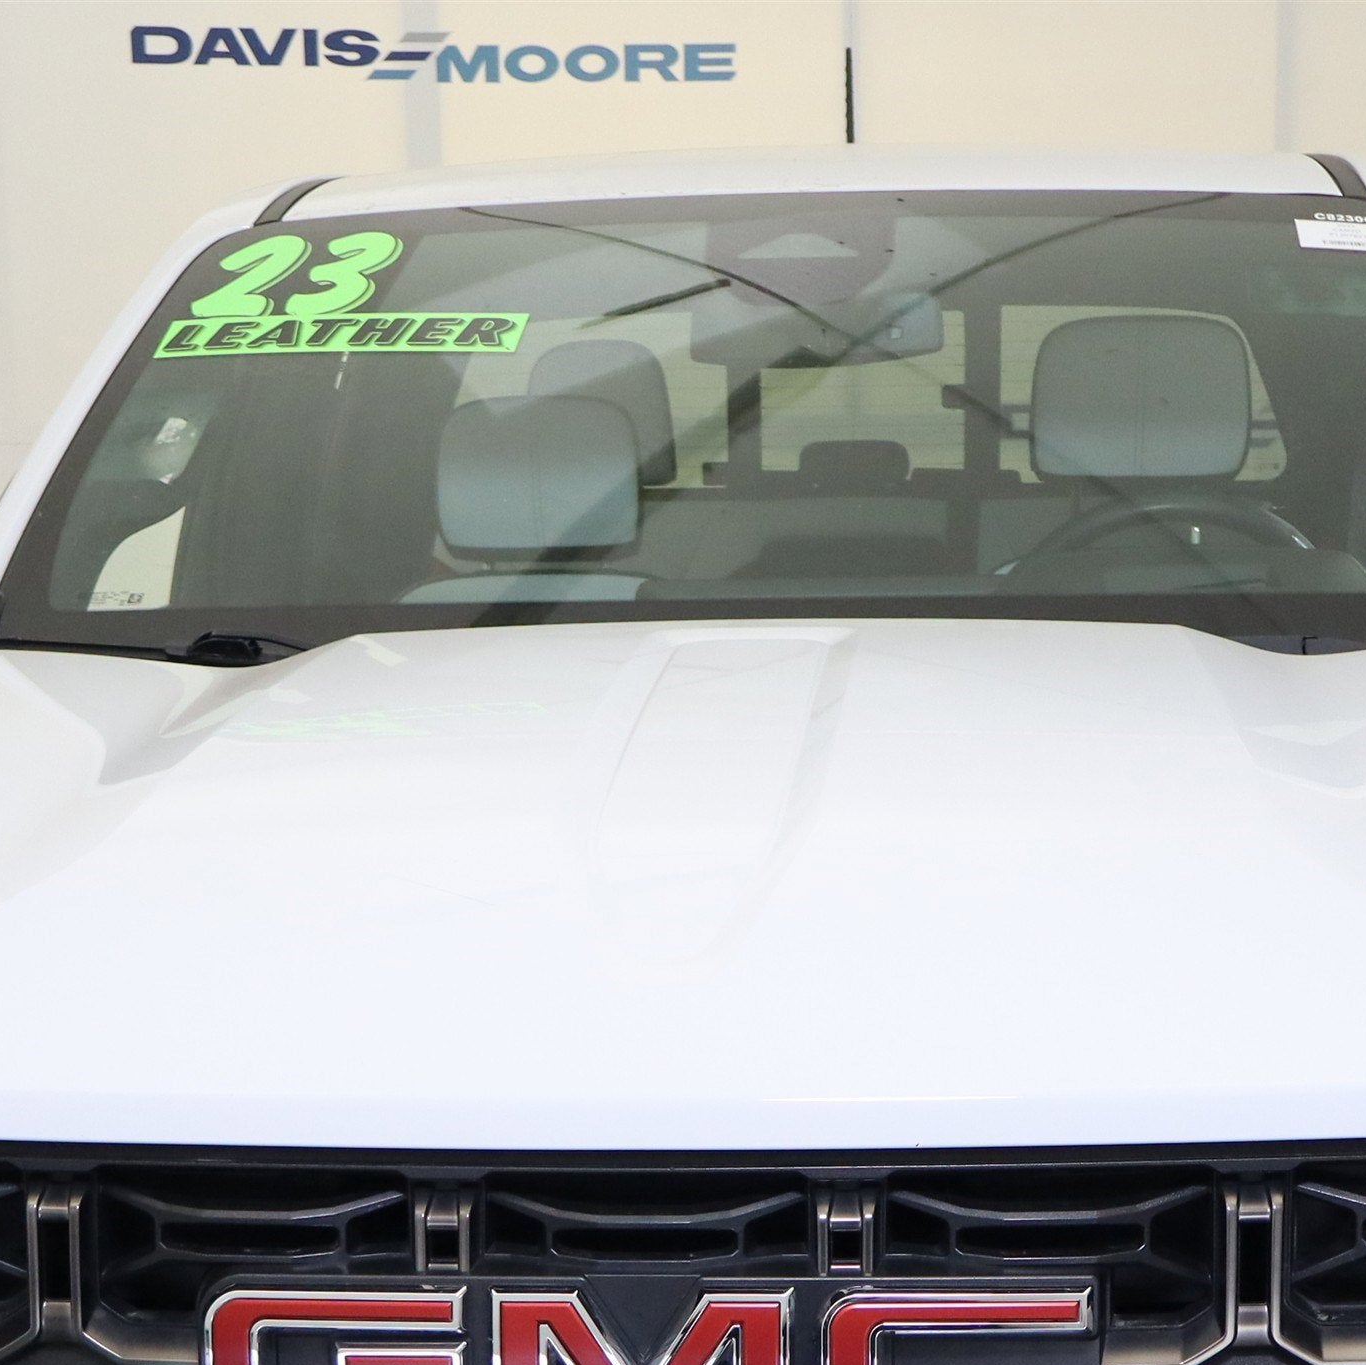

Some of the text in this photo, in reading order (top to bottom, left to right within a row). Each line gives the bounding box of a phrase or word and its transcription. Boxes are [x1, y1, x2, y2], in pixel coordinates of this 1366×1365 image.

[130, 26, 737, 83] DAVIS MOORE
[191, 231, 403, 318] 23
[163, 317, 516, 352] LEATHER
